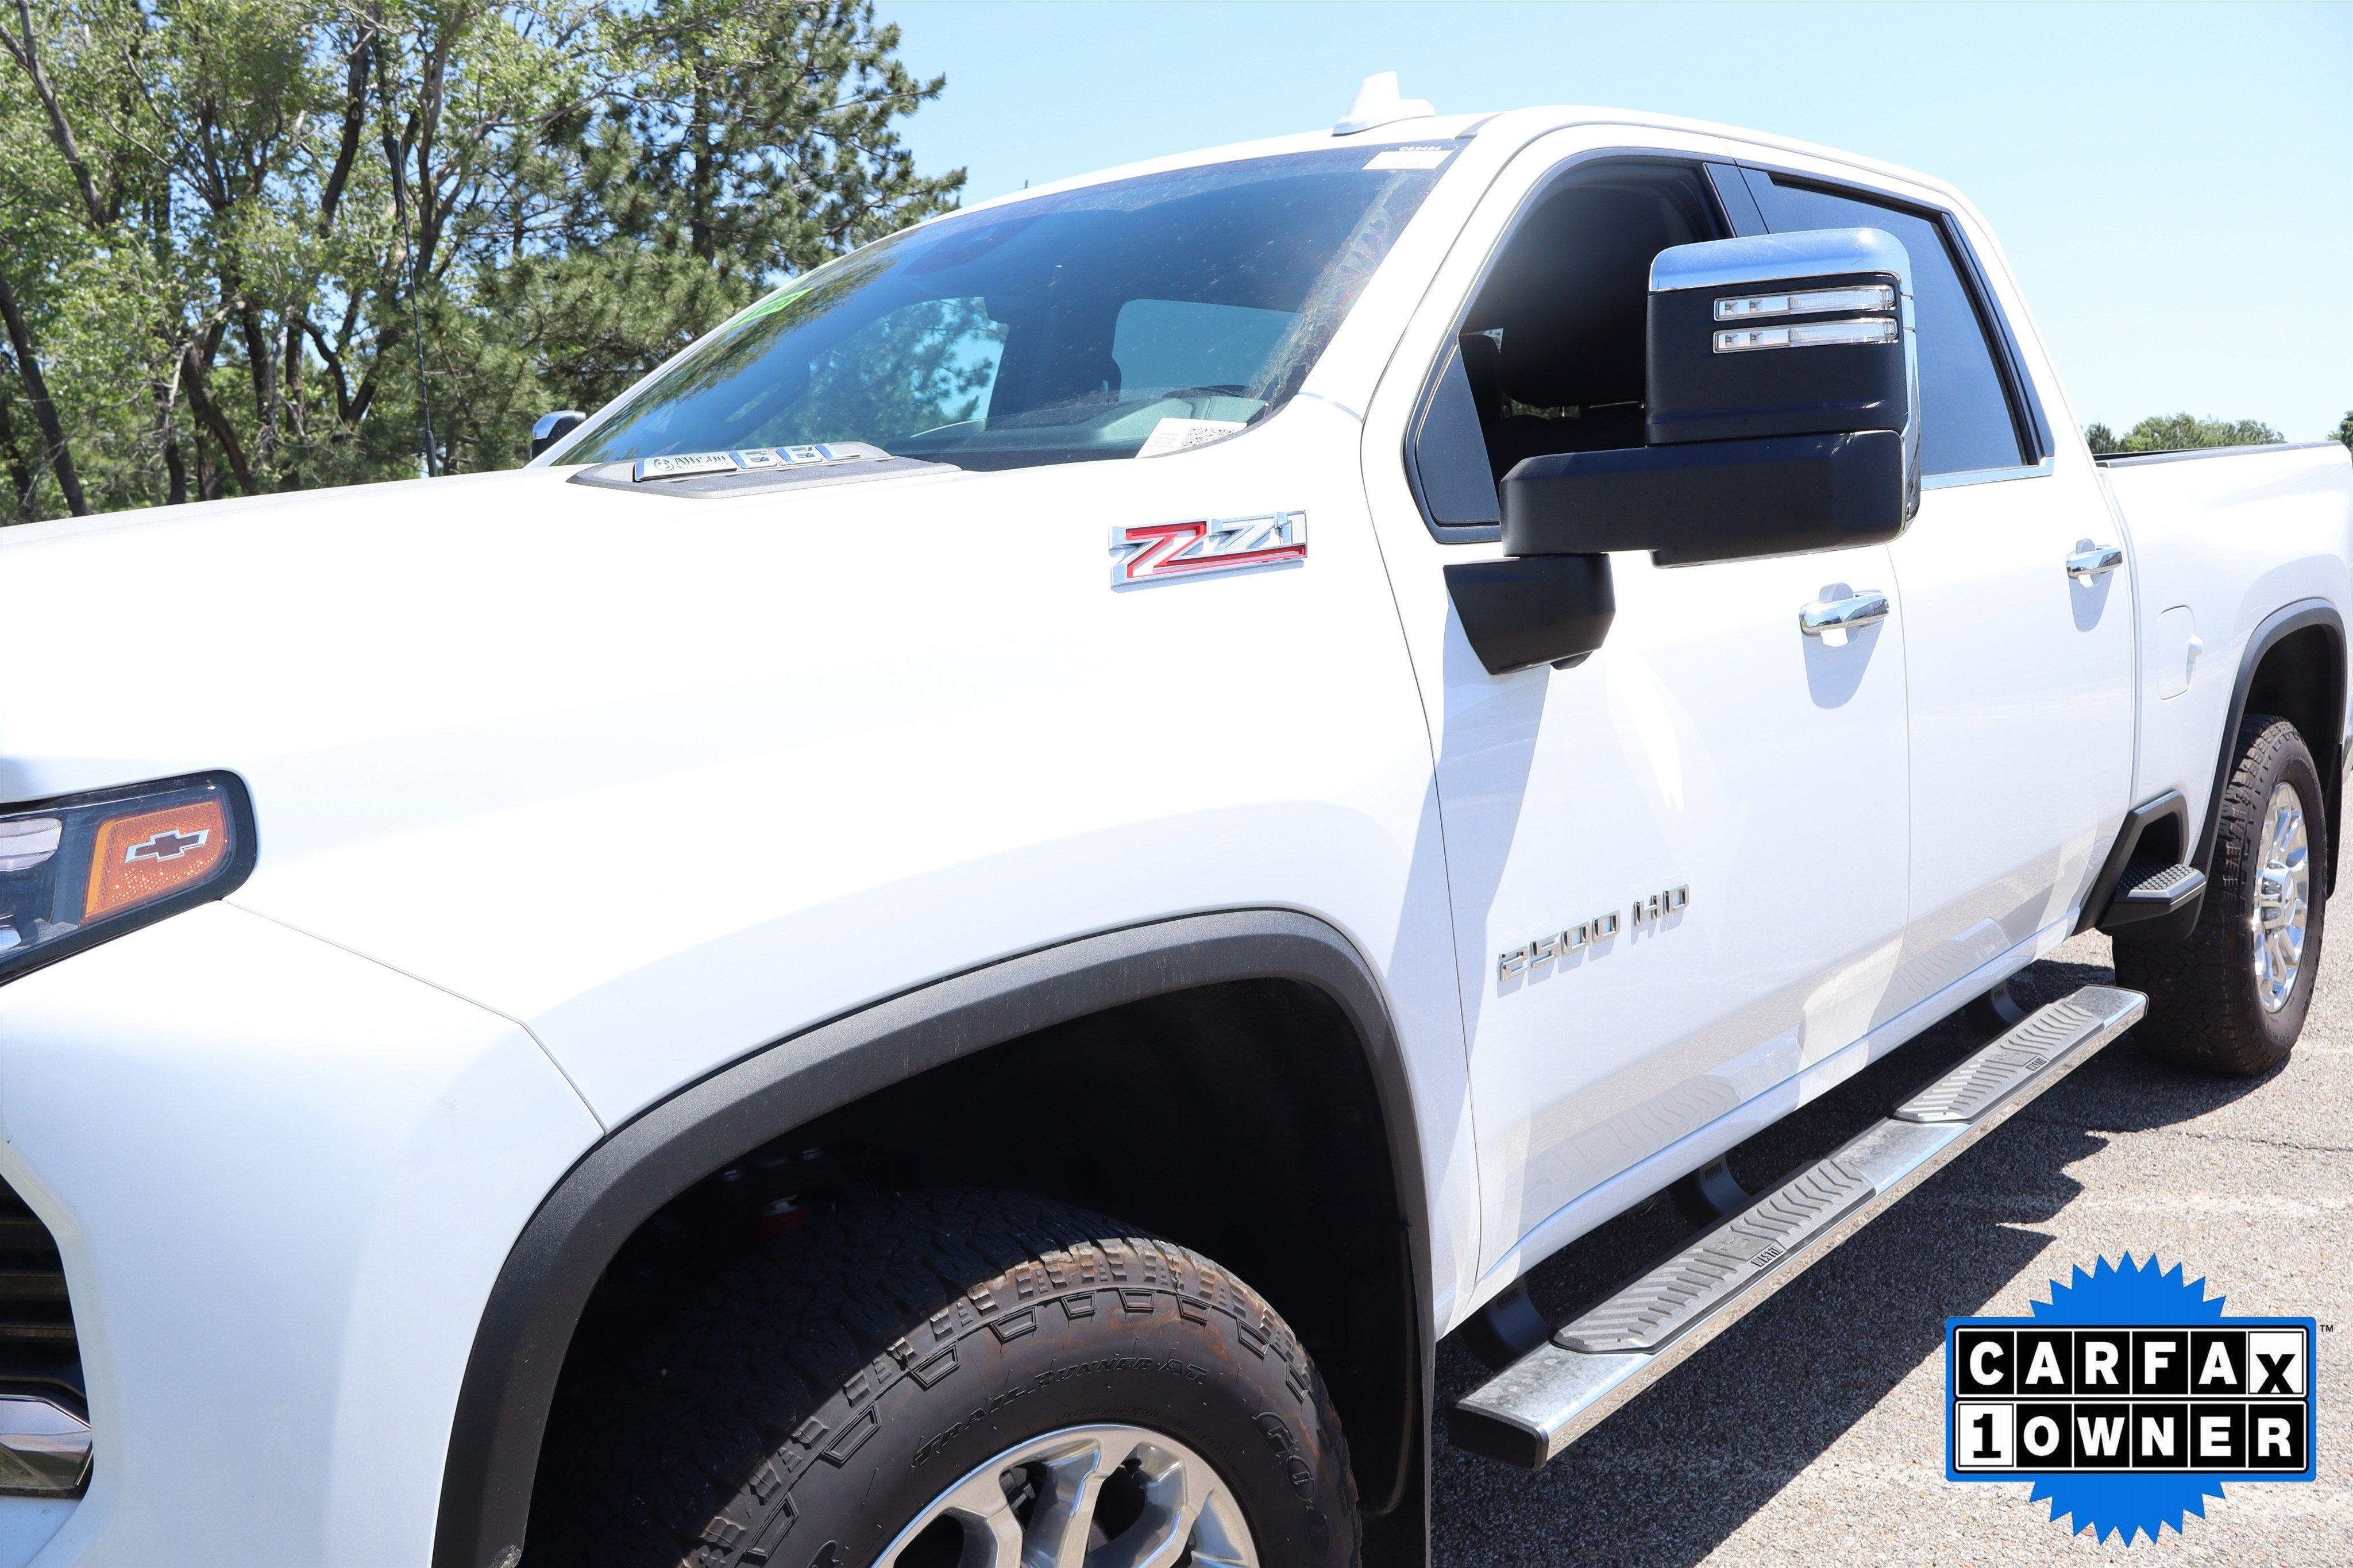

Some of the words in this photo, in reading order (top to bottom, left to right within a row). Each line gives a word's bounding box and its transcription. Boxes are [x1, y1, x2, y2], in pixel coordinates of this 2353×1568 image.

[674, 454, 727, 466] Allison
[729, 443, 861, 469] 6.6L
[1109, 510, 1307, 593] Z71
[1499, 909, 1621, 981] 2500
[1634, 883, 1689, 926] HD
[1161, 1358, 1210, 1381] AT
